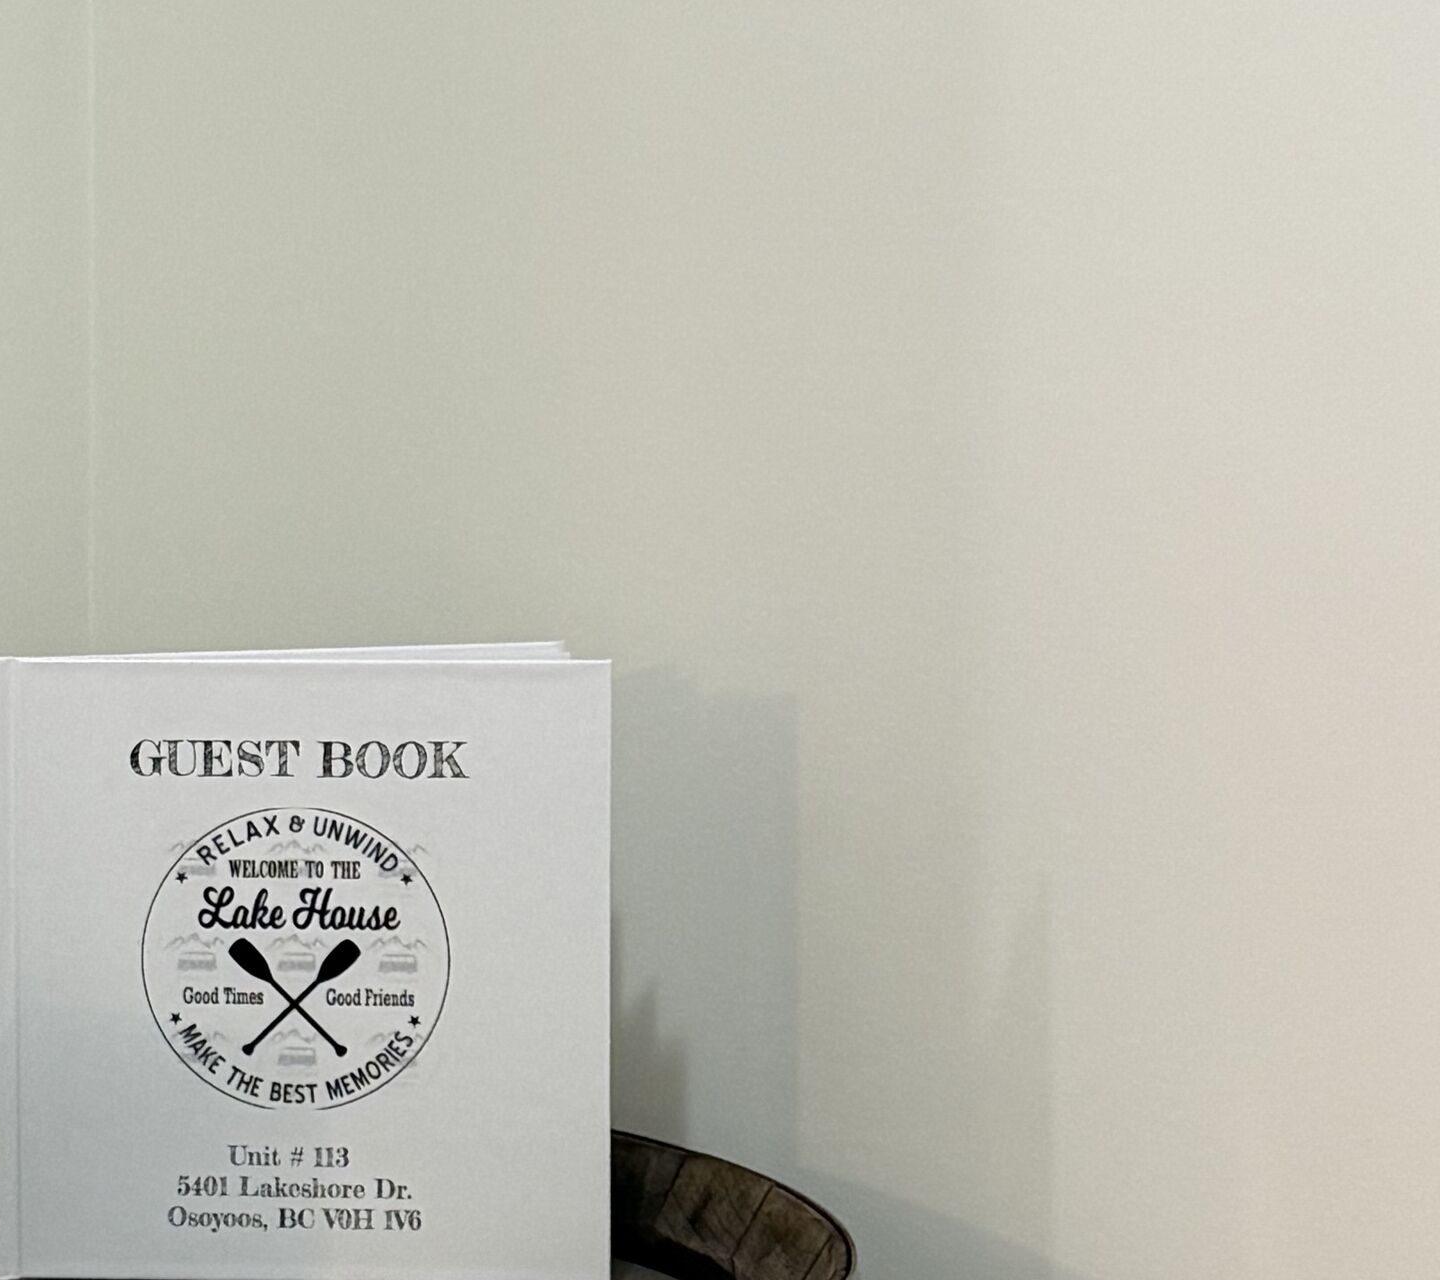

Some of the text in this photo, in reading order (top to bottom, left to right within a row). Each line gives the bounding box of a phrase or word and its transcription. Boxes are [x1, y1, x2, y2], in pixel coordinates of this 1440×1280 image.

[130, 738, 470, 780] GUEST BOOK
[196, 815, 399, 872] RELAX & UNWIND
[229, 859, 361, 880] WELCOME TO THE
[197, 885, 401, 931] Lake House
[183, 986, 264, 1006] Good Times
[326, 988, 415, 1007] Good Friends
[178, 1023, 414, 1104] MAKE THE BEST MEMORIES
[228, 1144, 350, 1168] Unit # 113
[177, 1174, 413, 1200] 5401 Lakeshore Dr.
[167, 1205, 269, 1233] Osoyoos,
[277, 1207, 315, 1230] BC
[384, 1209, 423, 1231] 1V6
